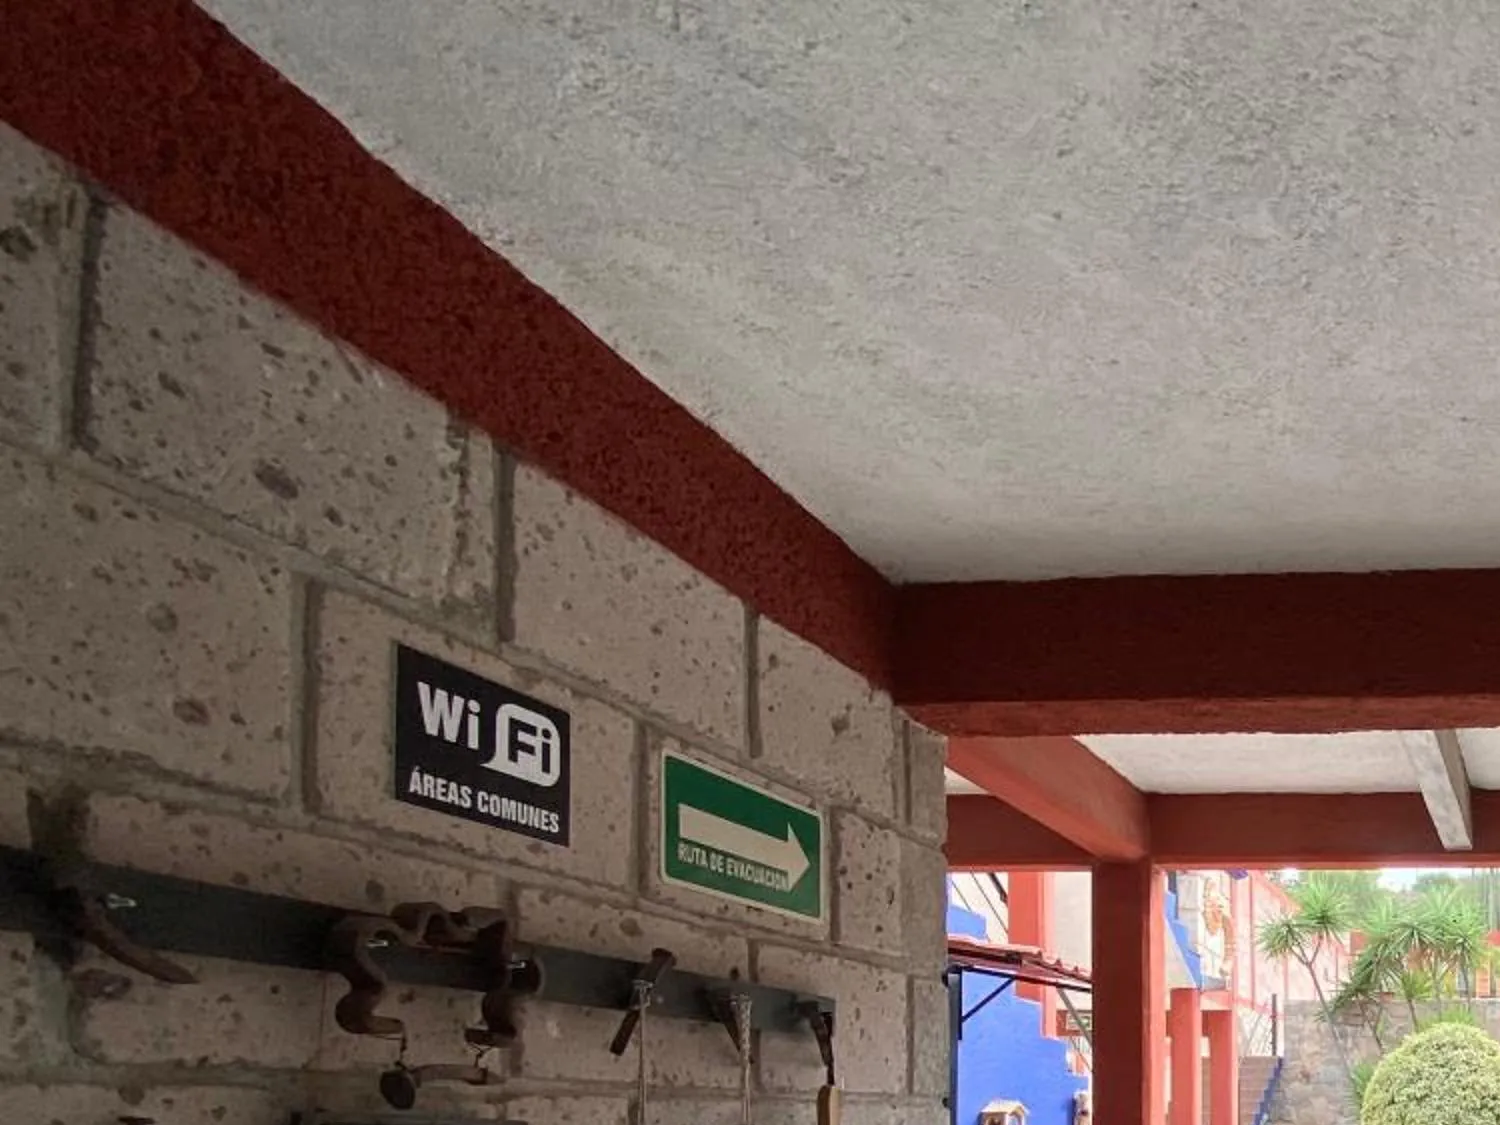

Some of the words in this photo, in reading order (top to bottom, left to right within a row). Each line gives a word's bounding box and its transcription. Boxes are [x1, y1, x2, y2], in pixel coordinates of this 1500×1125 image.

[416, 681, 481, 750] Wi
[409, 765, 472, 808] ÁREAS
[477, 791, 560, 833] COMUNES
[678, 841, 708, 868] RUTA
[709, 852, 726, 873] DE
